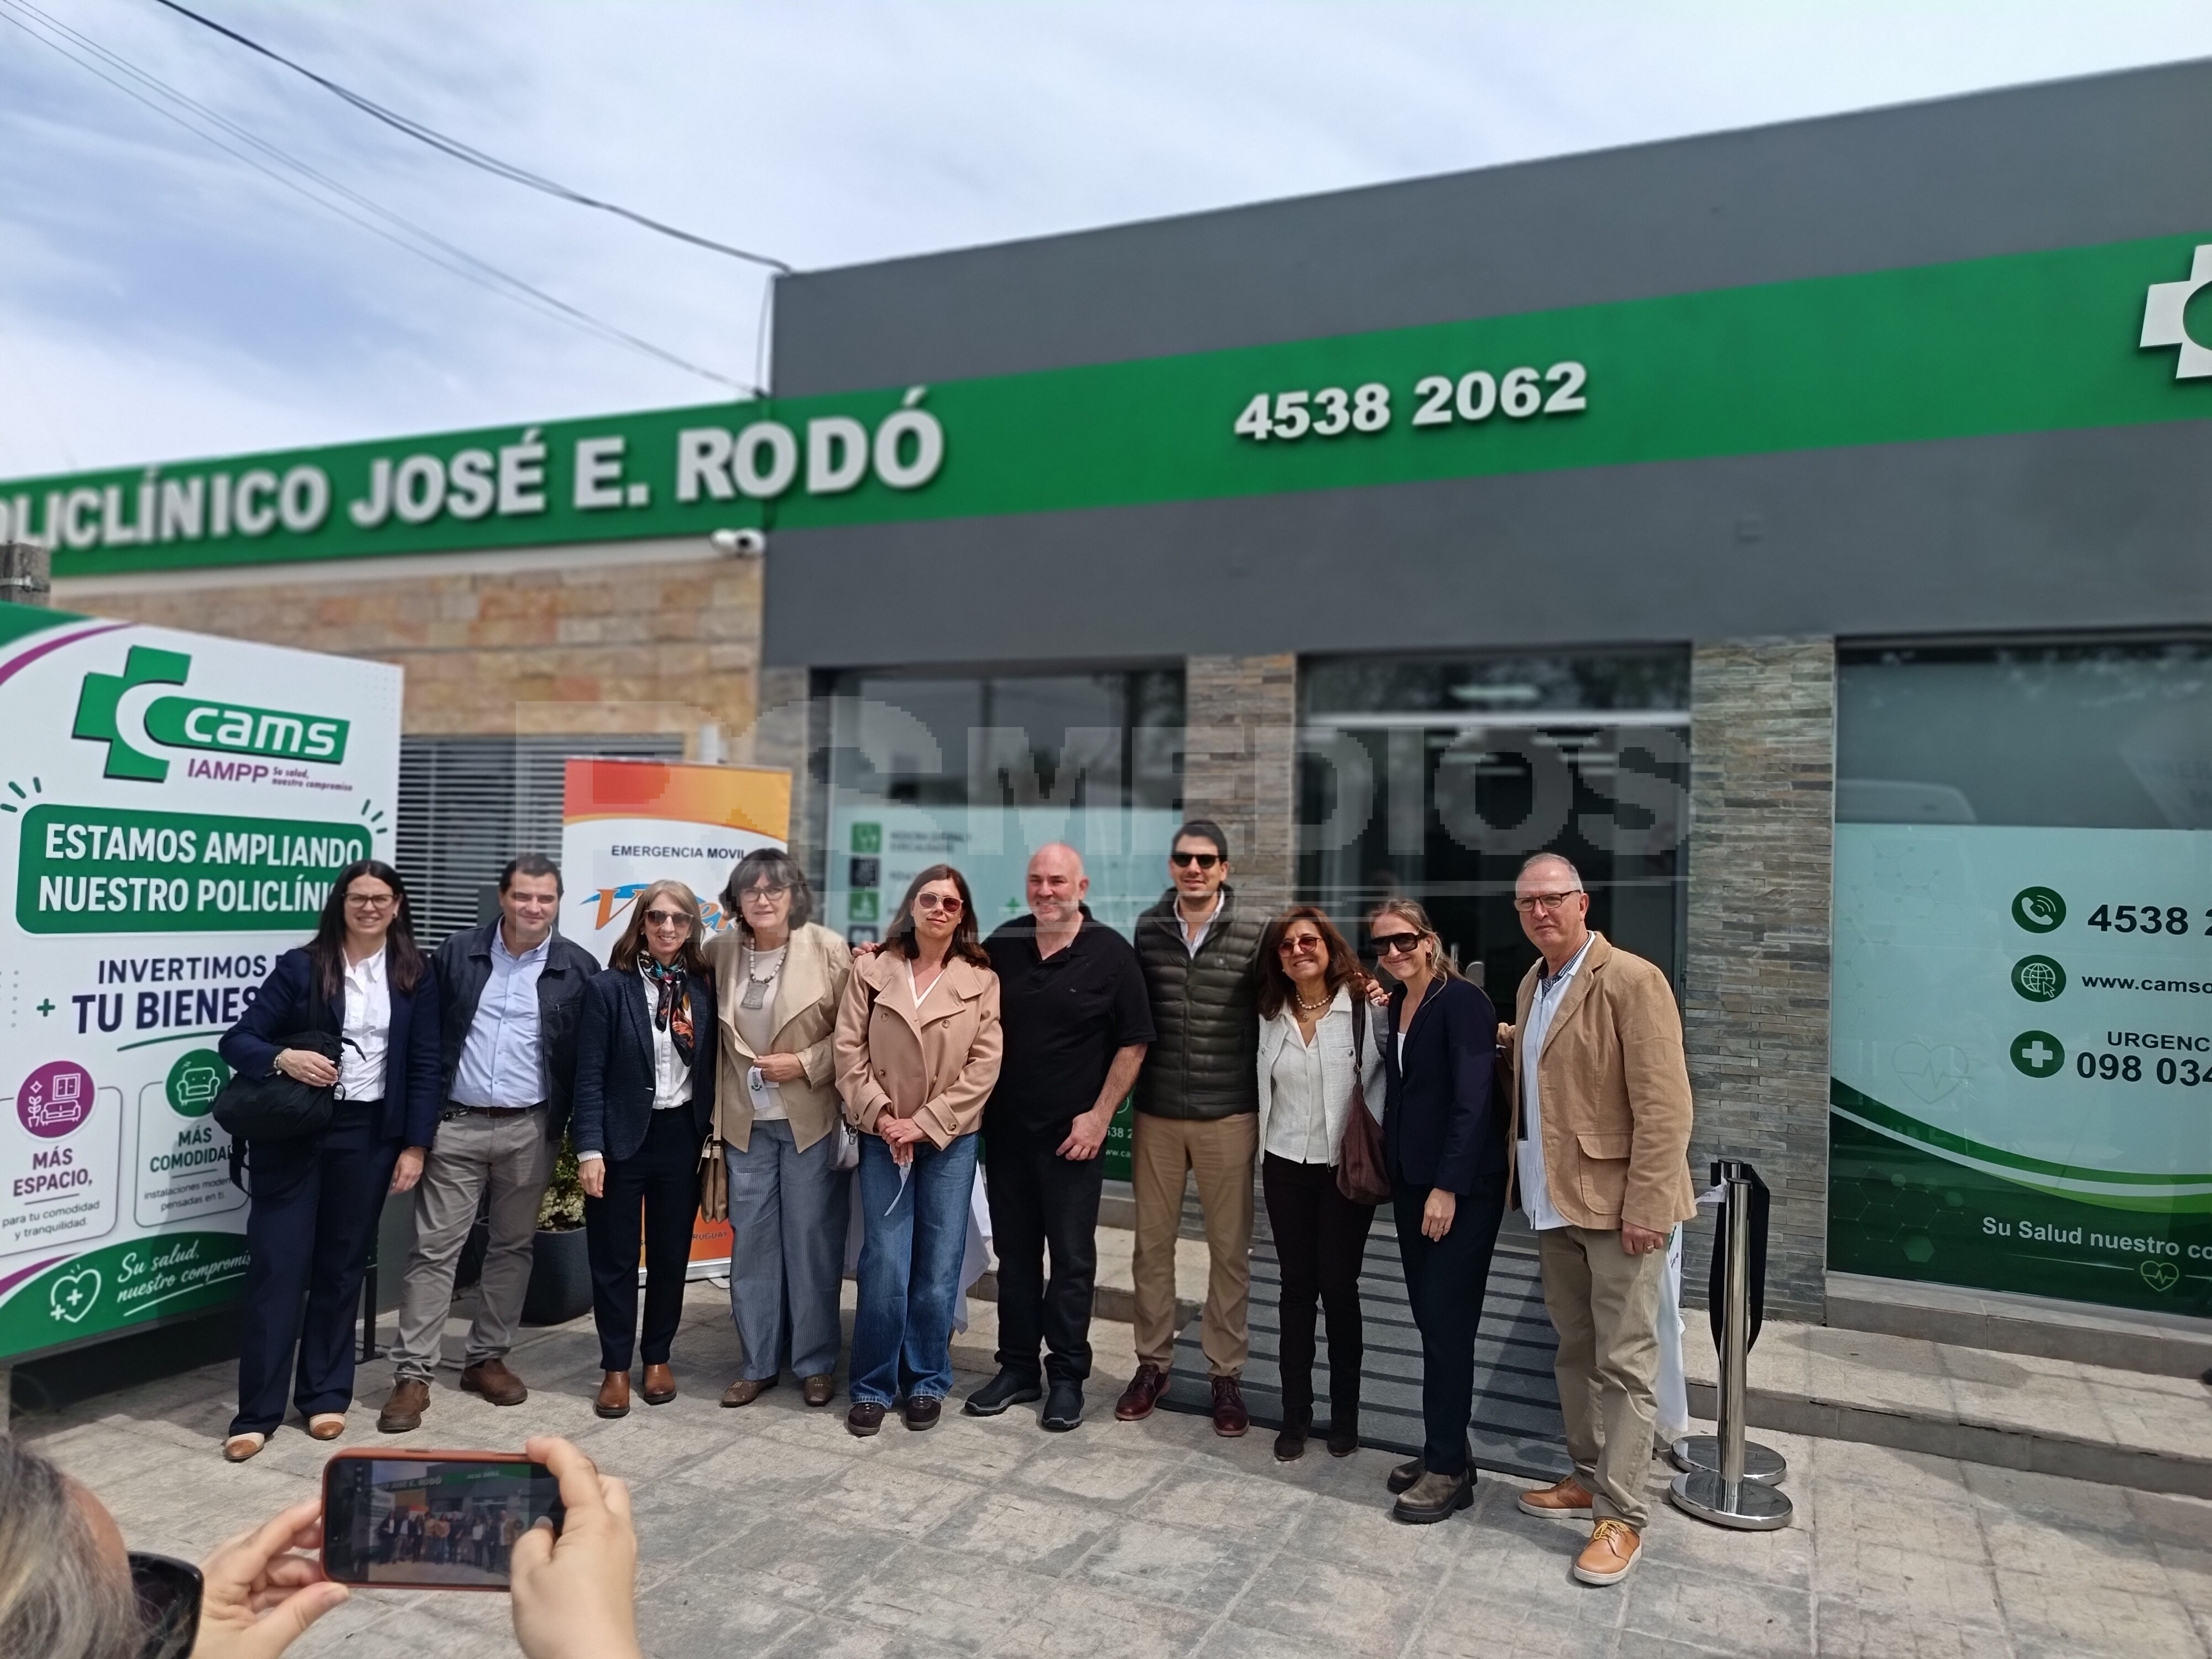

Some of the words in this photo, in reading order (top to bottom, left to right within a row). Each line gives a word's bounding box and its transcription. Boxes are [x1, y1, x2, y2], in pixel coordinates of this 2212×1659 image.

[1234, 383, 1390, 440] 4538
[1412, 361, 1587, 426] 2062
[348, 427, 546, 527] JOSÉ
[573, 436, 649, 509] E.
[676, 385, 943, 501] RODÓ
[185, 707, 338, 756] cams
[187, 758, 269, 783] IAMPP
[272, 778, 303, 787] nuestro
[306, 781, 353, 791] compromiso
[273, 766, 283, 775] Su
[45, 822, 197, 863] ESTAMOS
[203, 831, 363, 868] AMPLIANDO
[611, 846, 703, 858] EMERGENCIA
[707, 848, 745, 859] MOVIL
[38, 875, 189, 912] NUESTRO
[197, 874, 335, 912] POLICLÍNI
[2088, 904, 2189, 935] 4538
[98, 954, 267, 984] INVERTIMOS
[2081, 975, 2212, 994] www.camso
[71, 993, 123, 1034] TU
[2107, 1031, 2211, 1052] URGENC
[2077, 1052, 2142, 1082] 098
[178, 1125, 212, 1147] MÁS
[33, 1146, 73, 1171] MÁS
[13, 1168, 92, 1197] ESPACIO,
[144, 1182, 200, 1200] instalaciones
[202, 1177, 231, 1189] modern
[2, 1215, 27, 1229] para
[29, 1213, 40, 1222] tu
[43, 1199, 100, 1219] comodidad
[161, 1195, 203, 1212] pensadas
[205, 1193, 216, 1202] en
[14, 1231, 21, 1241] y
[693, 1231, 728, 1240] RUGUAY
[1983, 1217, 2011, 1237] Su
[2018, 1220, 2082, 1245] Salud
[2090, 1233, 2180, 1256] nuestro
[117, 1252, 147, 1283] Su
[117, 1272, 176, 1303] nuestro
[181, 1250, 251, 1284] compromis
